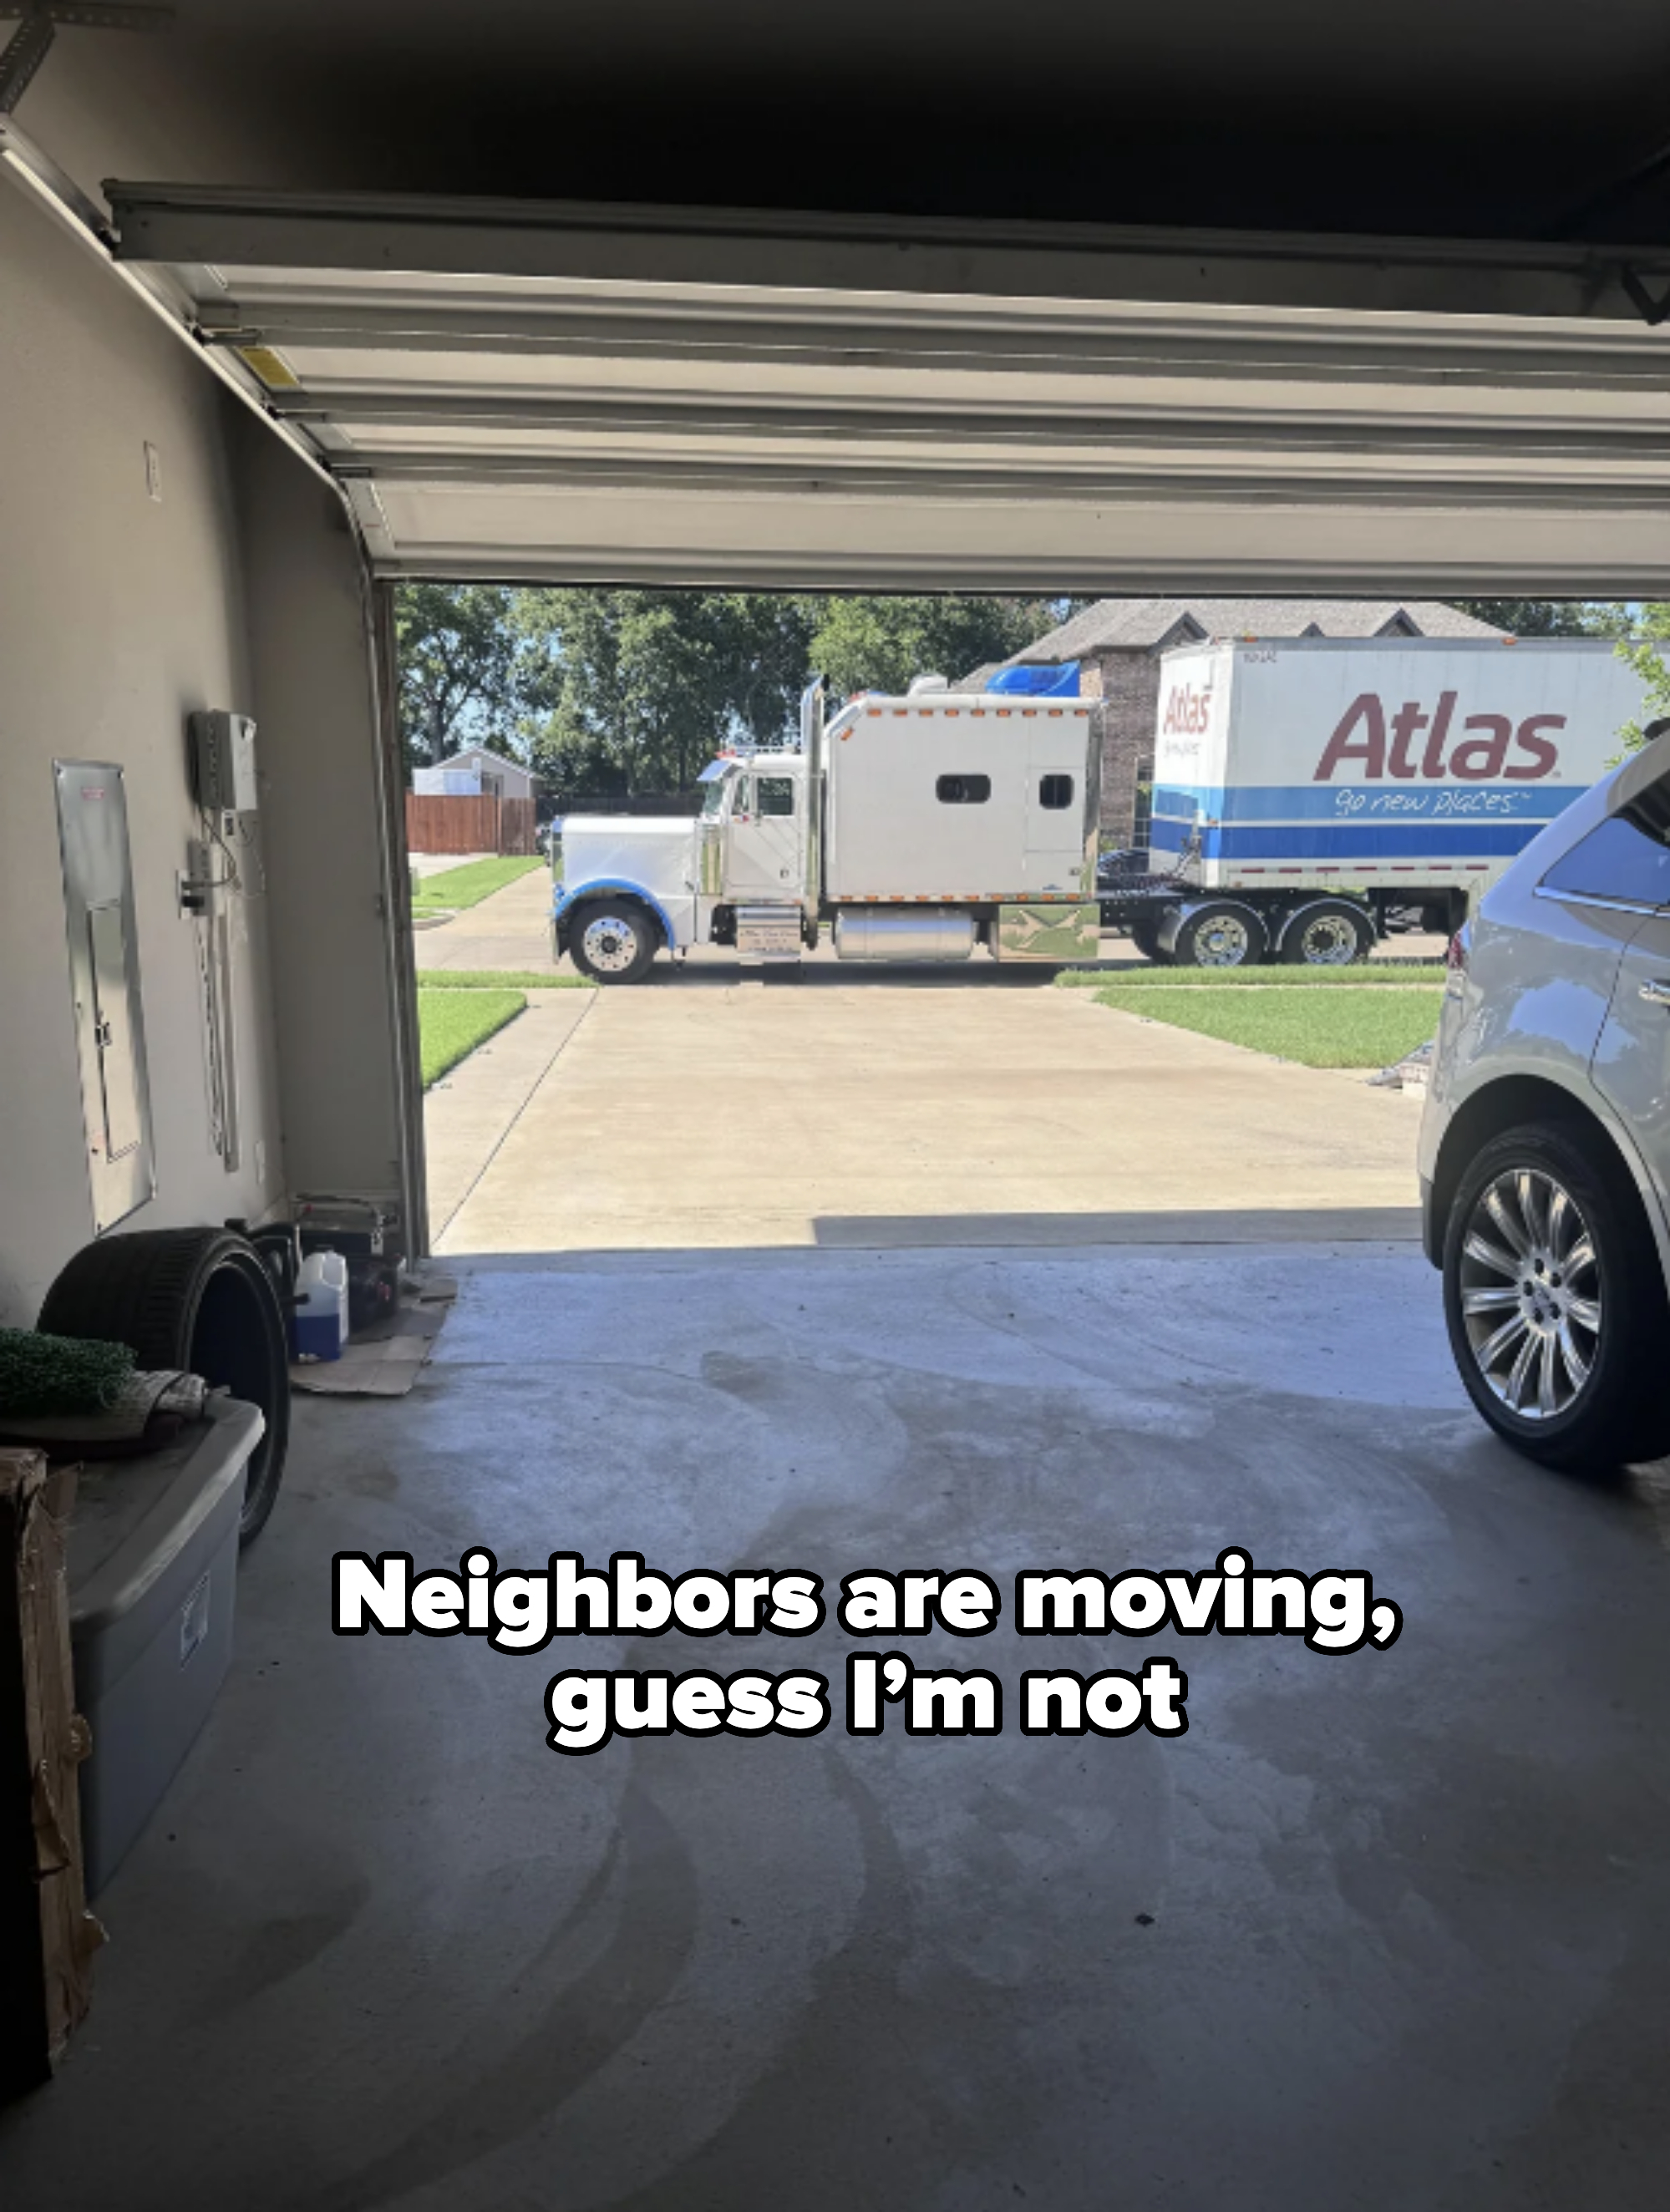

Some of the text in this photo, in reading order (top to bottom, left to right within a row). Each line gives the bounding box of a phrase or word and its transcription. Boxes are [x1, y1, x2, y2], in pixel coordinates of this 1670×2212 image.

[1163, 683, 1211, 735] Atlas
[1313, 691, 1567, 780] Atlas
[1335, 789, 1366, 816] go
[1370, 794, 1429, 813] new
